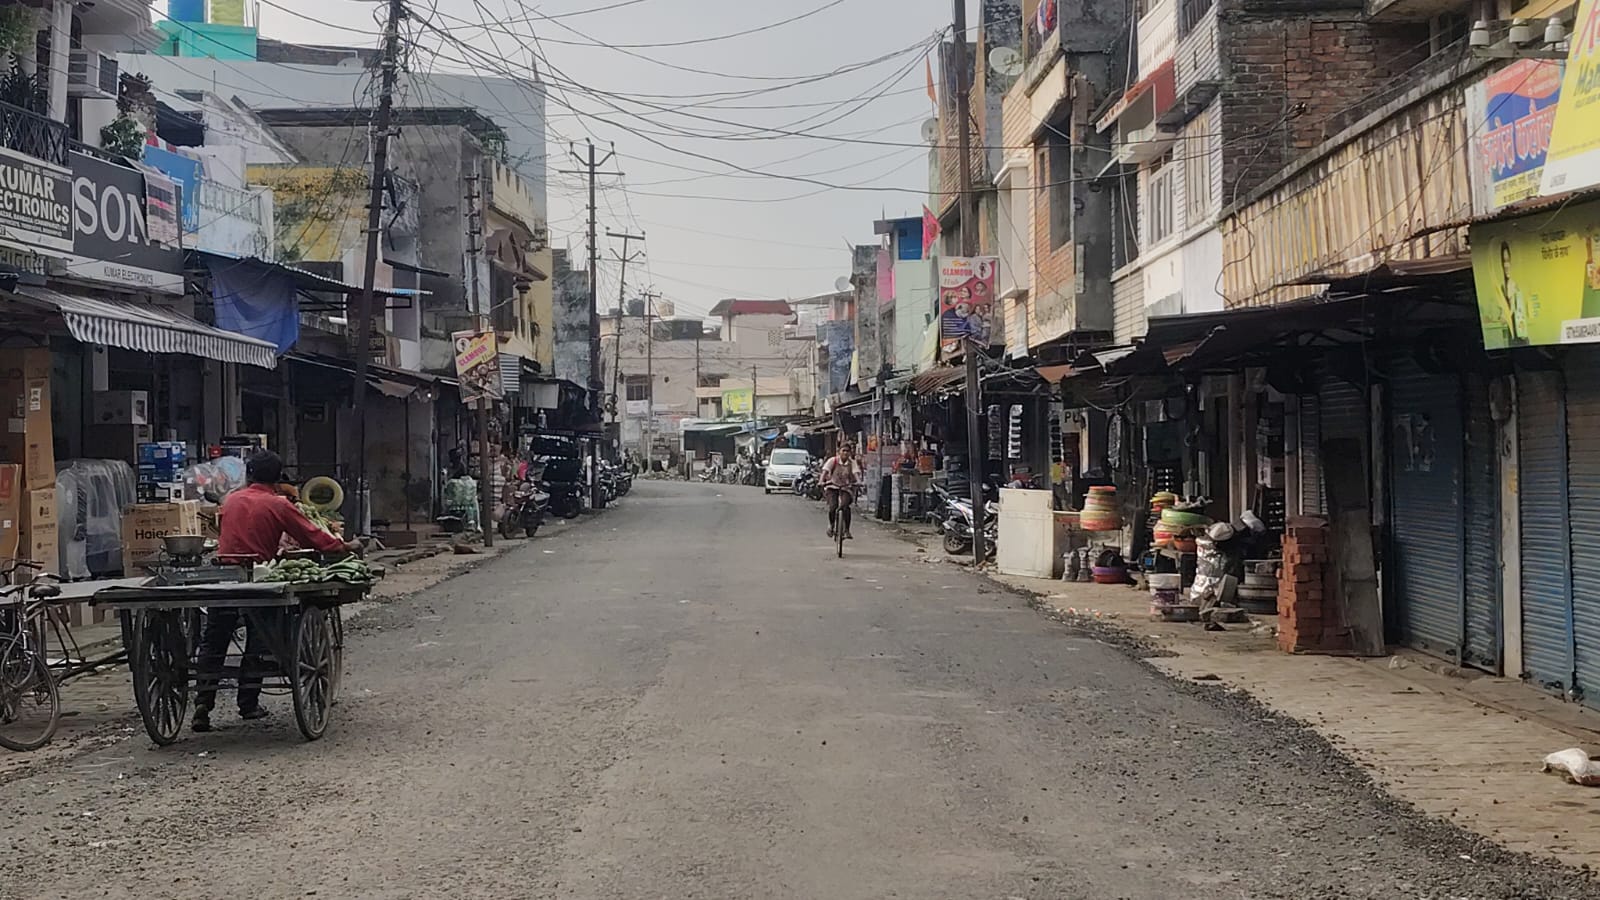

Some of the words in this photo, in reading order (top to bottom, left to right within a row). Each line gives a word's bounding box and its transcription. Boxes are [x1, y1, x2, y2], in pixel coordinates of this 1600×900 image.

[0, 164, 55, 201] KUMAR
[74, 176, 171, 250] SON
[135, 528, 169, 540] Haier
